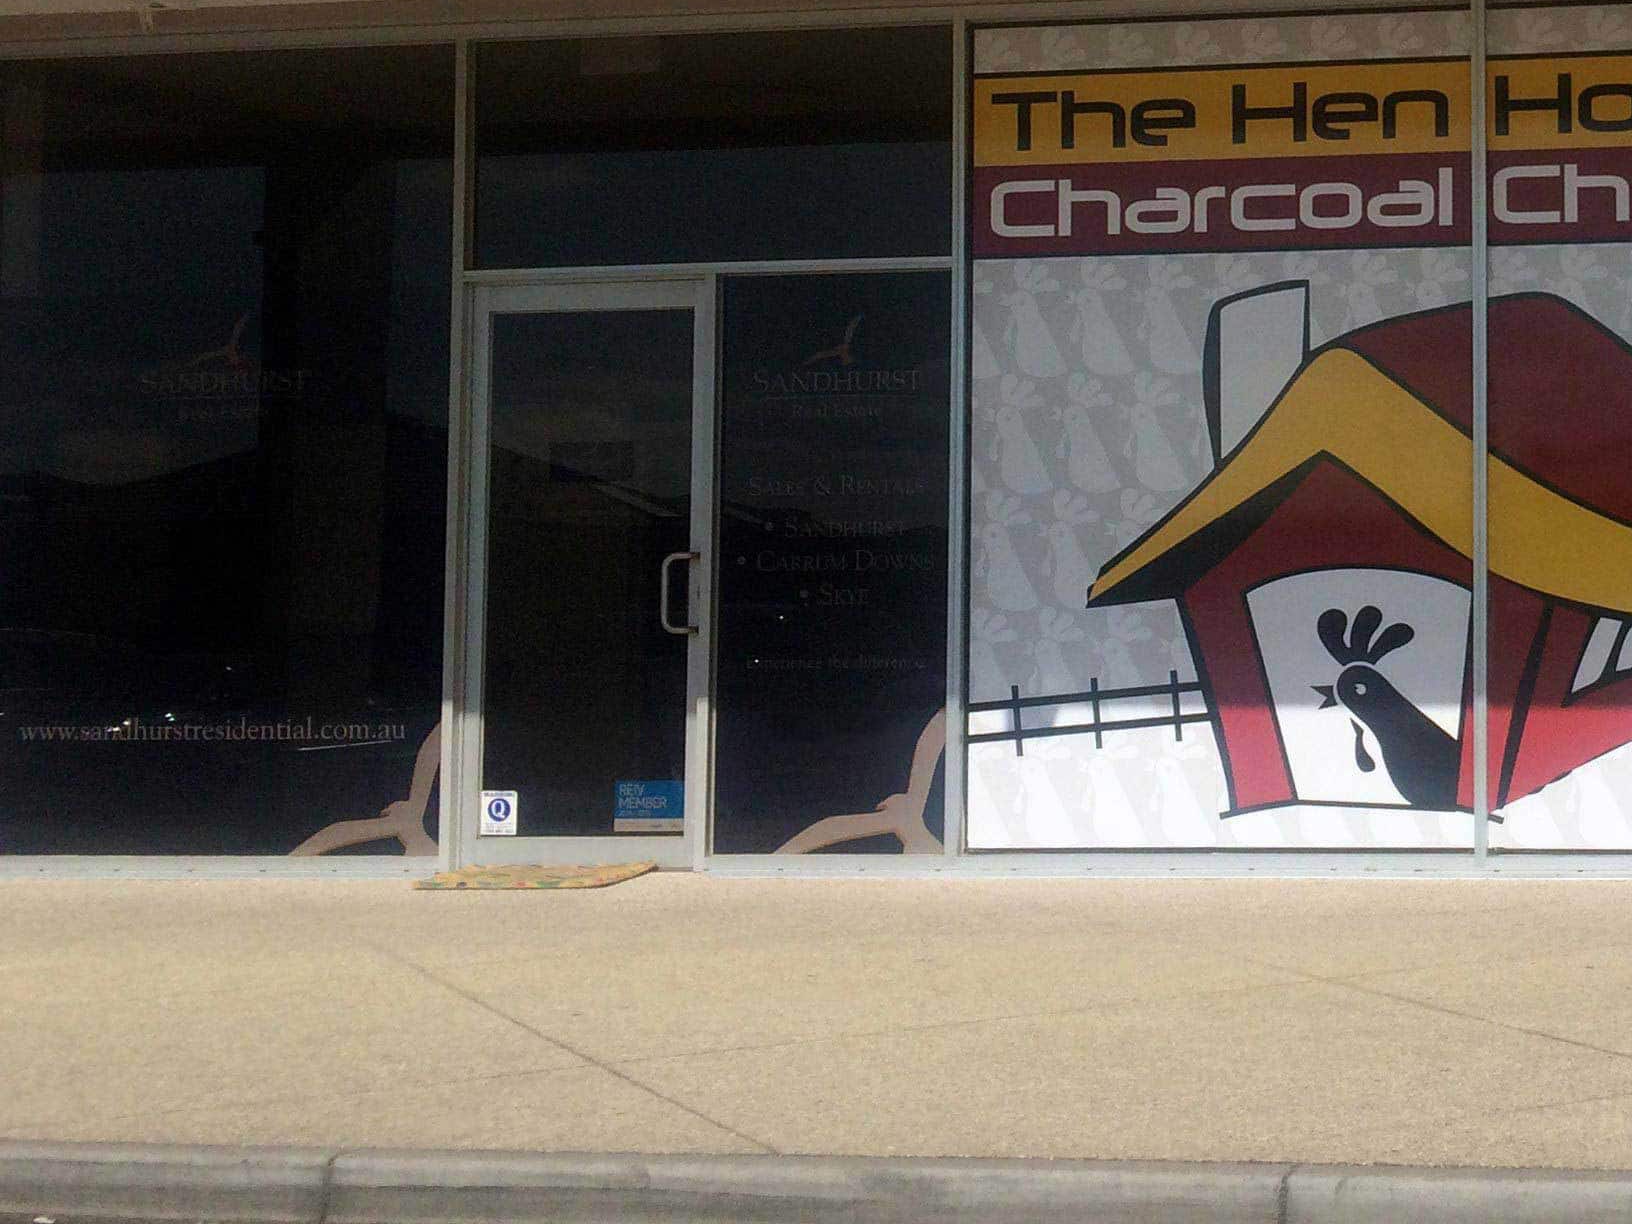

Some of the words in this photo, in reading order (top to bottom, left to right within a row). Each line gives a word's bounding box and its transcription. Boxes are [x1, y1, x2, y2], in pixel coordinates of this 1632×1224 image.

[991, 90, 1196, 153] The
[1231, 81, 1448, 144] Hen
[990, 168, 1454, 239] Charcoal
[618, 796, 667, 809] MEMBER
